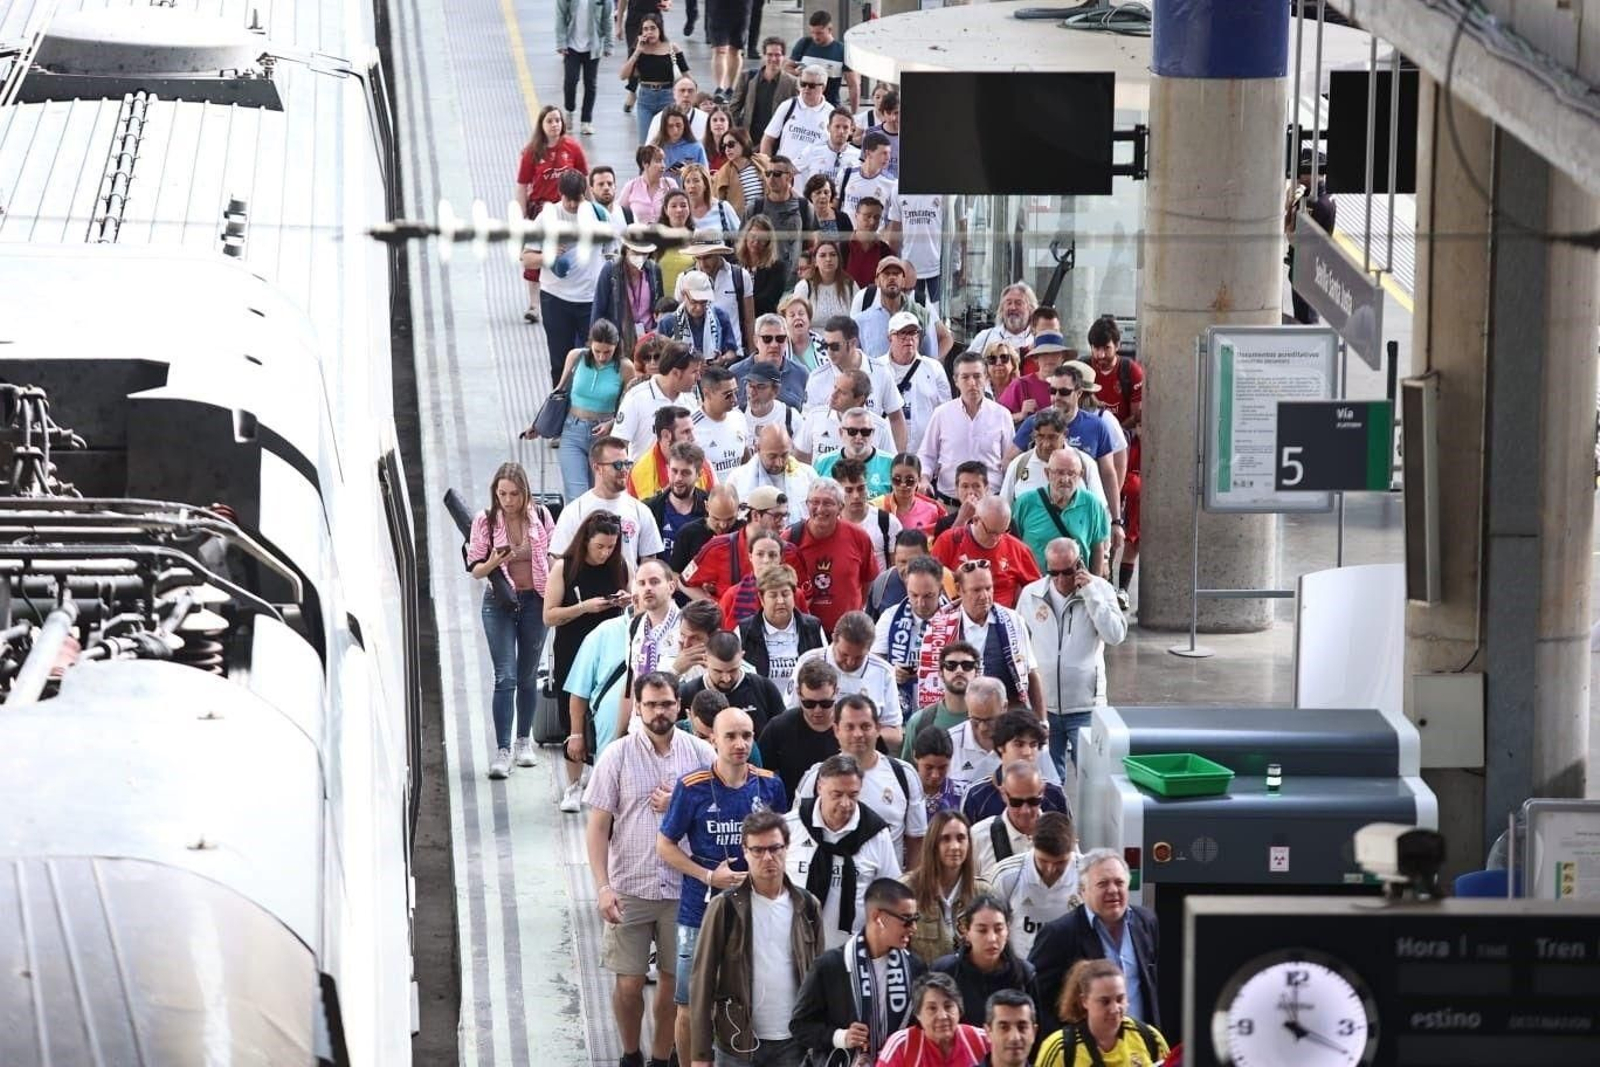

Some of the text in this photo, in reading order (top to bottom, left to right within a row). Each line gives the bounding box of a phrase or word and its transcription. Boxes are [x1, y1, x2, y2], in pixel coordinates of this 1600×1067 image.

[1281, 446, 1304, 486] 5
[1395, 936, 1450, 957] Hora
[1535, 937, 1586, 958] Tren
[1237, 1018, 1254, 1036] 9
[1338, 1018, 1355, 1036] 3
[1410, 1007, 1482, 1029] estino
